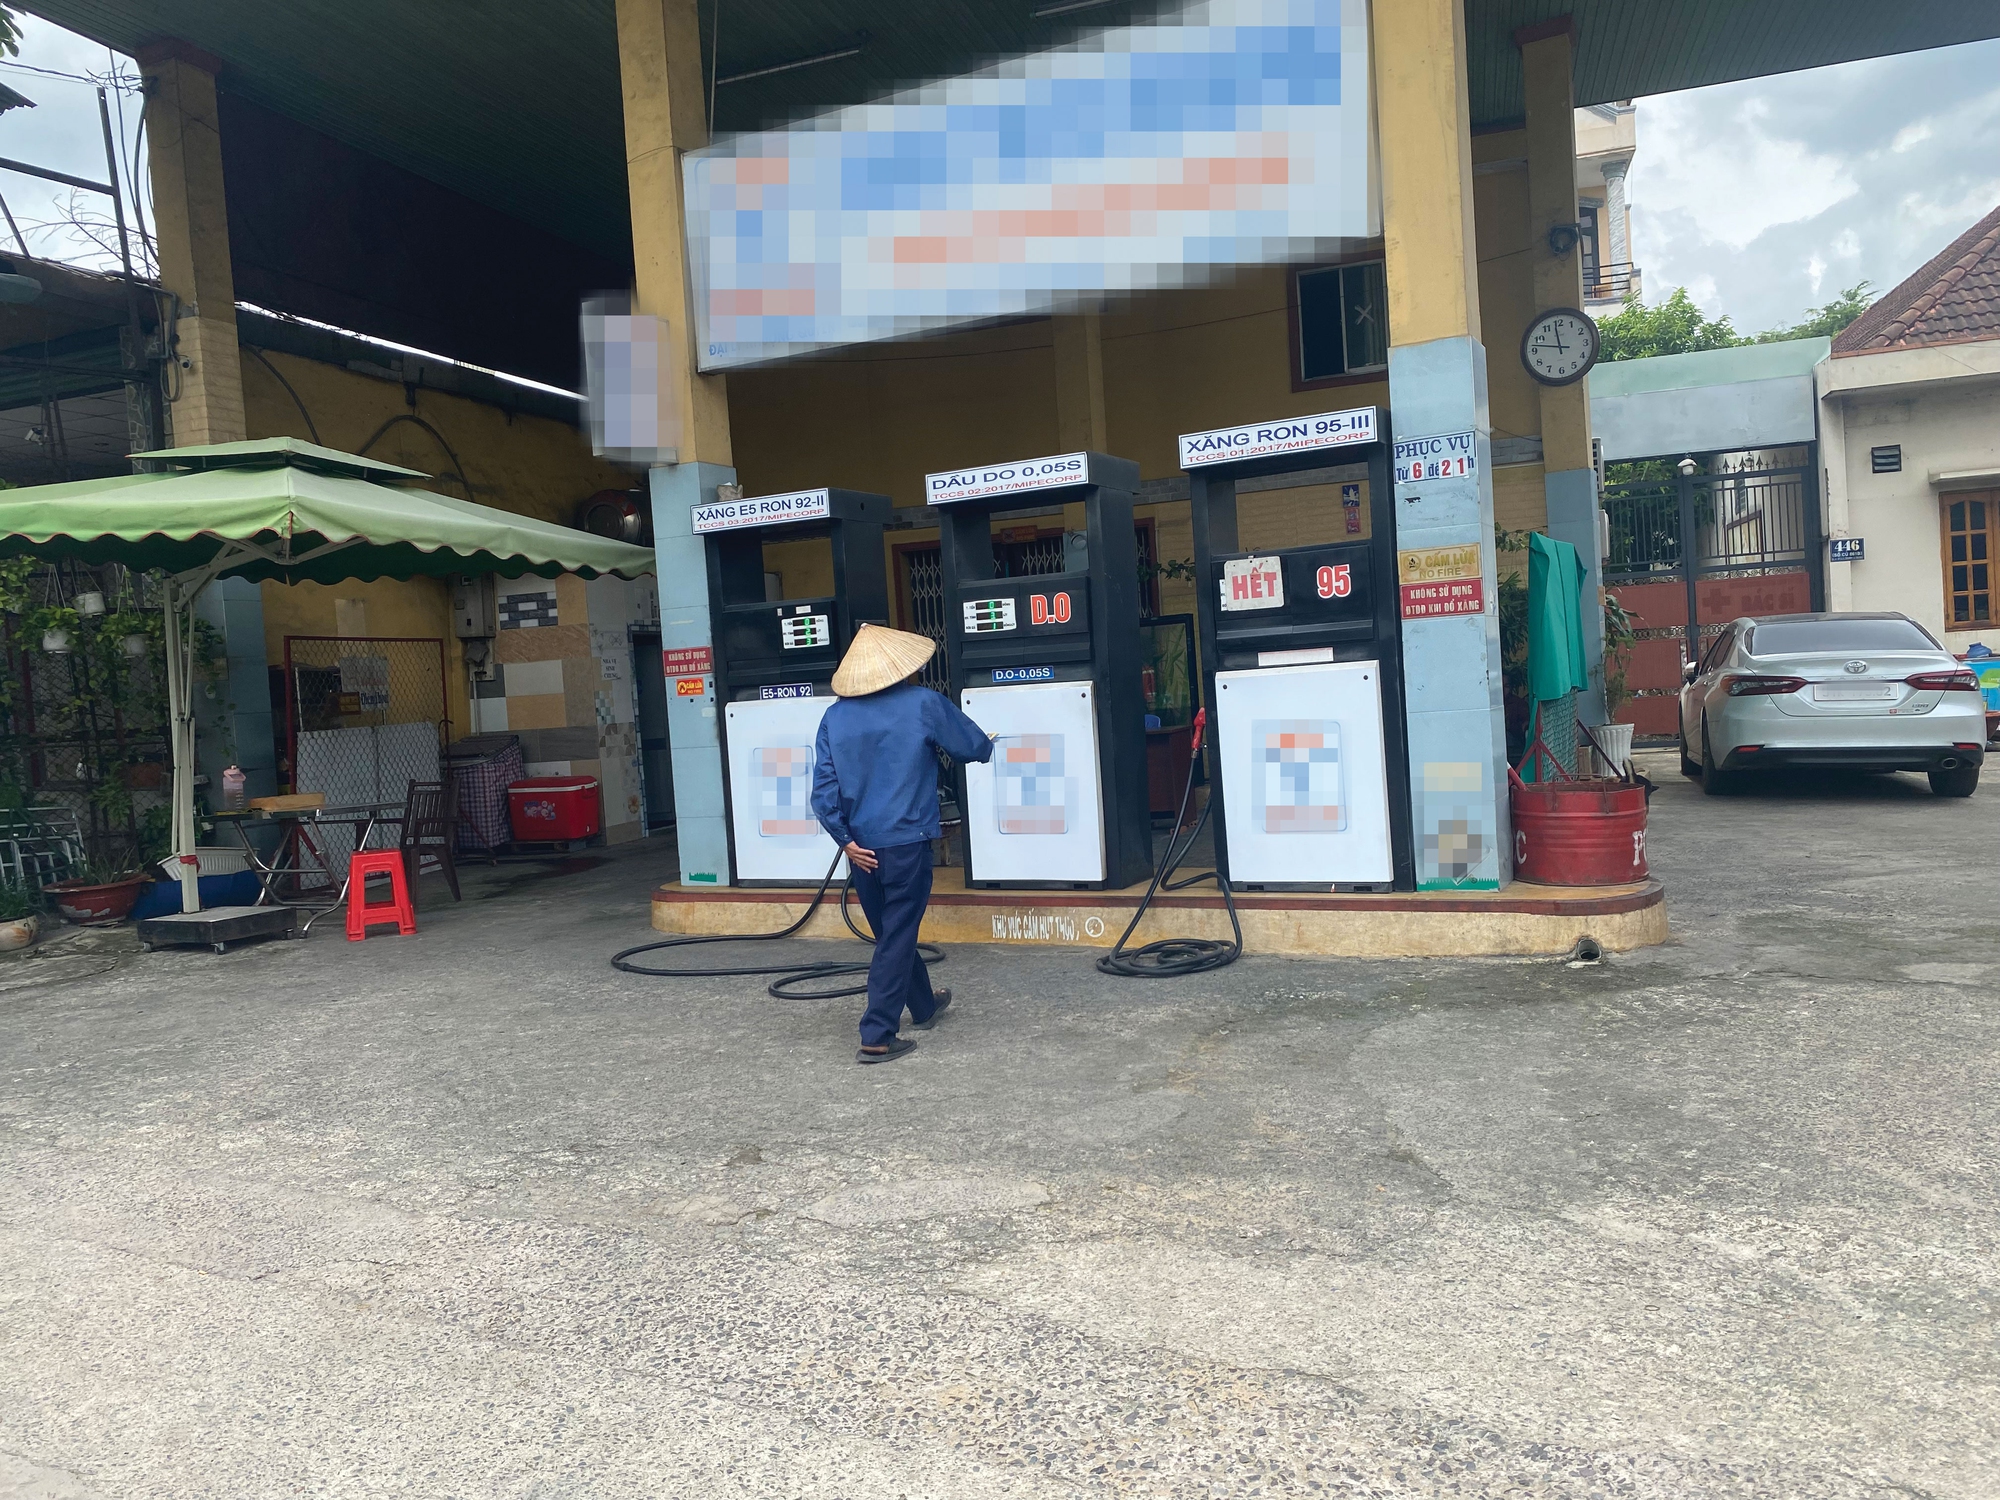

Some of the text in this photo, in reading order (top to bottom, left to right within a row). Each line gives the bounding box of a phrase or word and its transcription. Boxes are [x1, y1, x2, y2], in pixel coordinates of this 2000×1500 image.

[1542, 324, 1551, 332] 11
[1534, 335, 1544, 343] 10
[1536, 358, 1542, 366] 8
[1187, 415, 1370, 454] XĂNG RON 95-III
[1187, 432, 1370, 462] TCCS 01:2017/MIPECORP
[1395, 434, 1470, 460] PHỤC VỤ
[984, 470, 1016, 482] DO
[1022, 460, 1082, 476] 0,05S
[1396, 467, 1409, 480] Từ
[1413, 462, 1422, 479] 6
[932, 474, 1082, 500] TCCS 02:2017/MIPECORP
[697, 495, 824, 521] XĂNG E5 RON 92-II
[1834, 540, 1860, 552] 446
[1425, 549, 1476, 567] CẤM LỬA
[1232, 563, 1276, 600] HẾT
[1317, 564, 1352, 598] 95
[1420, 568, 1462, 578] NO FIRE
[1410, 584, 1472, 599] KHÔNG SỬ DỤNG
[1030, 592, 1071, 624] D.O
[1429, 603, 1441, 613] KHI
[1458, 599, 1480, 612] XĂNG
[996, 668, 1050, 680] D.O-0,05S
[762, 686, 811, 698] E5-RON 92
[992, 915, 1006, 938] KHU
[1024, 908, 1038, 939] CẤM
